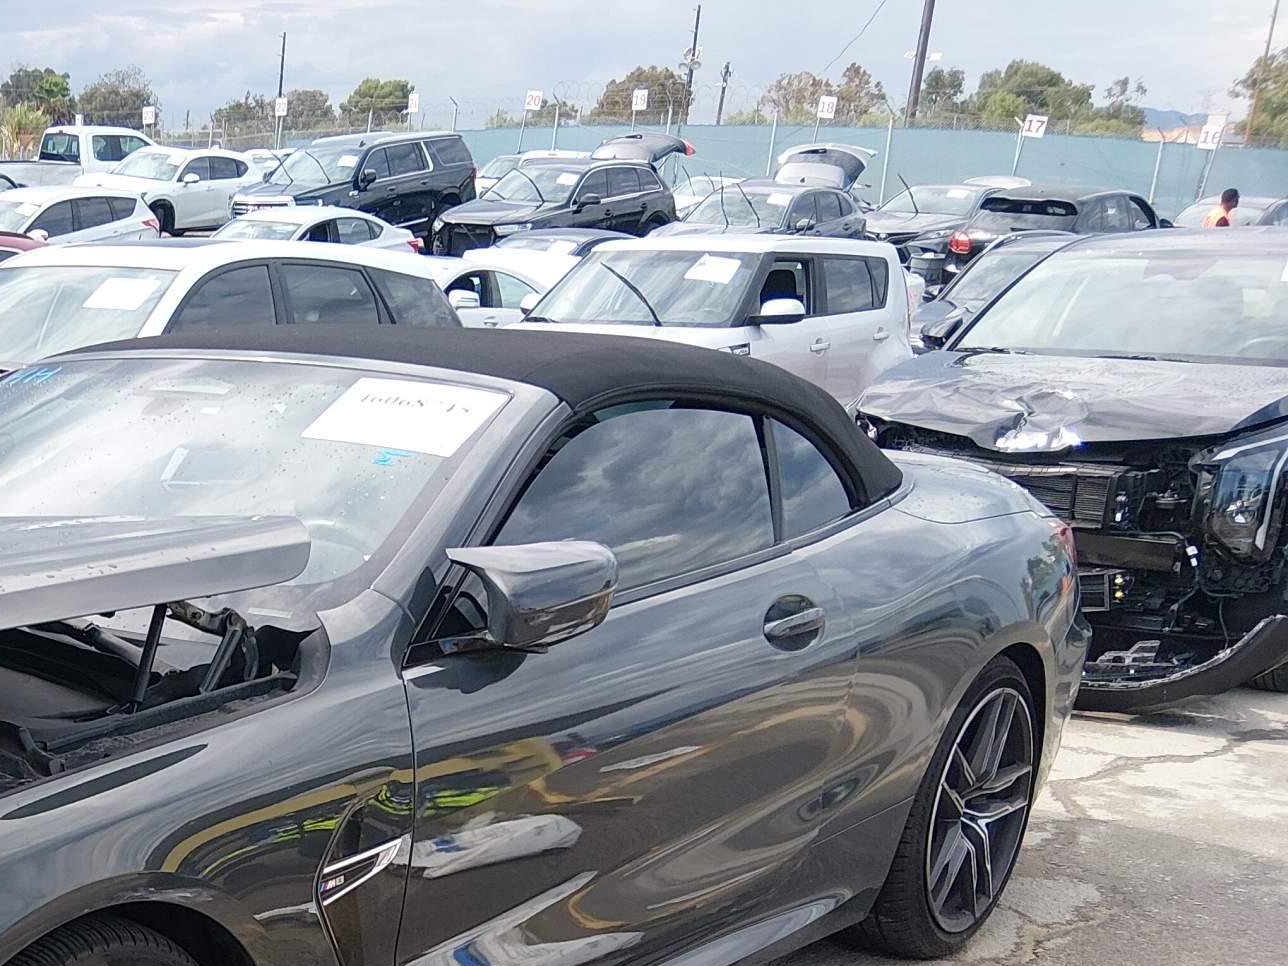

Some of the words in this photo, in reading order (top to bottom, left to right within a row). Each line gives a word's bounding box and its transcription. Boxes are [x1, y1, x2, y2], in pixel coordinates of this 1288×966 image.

[527, 95, 541, 106] 20
[818, 101, 835, 114] 18
[1024, 118, 1046, 133] 17
[1199, 130, 1221, 144] 16
